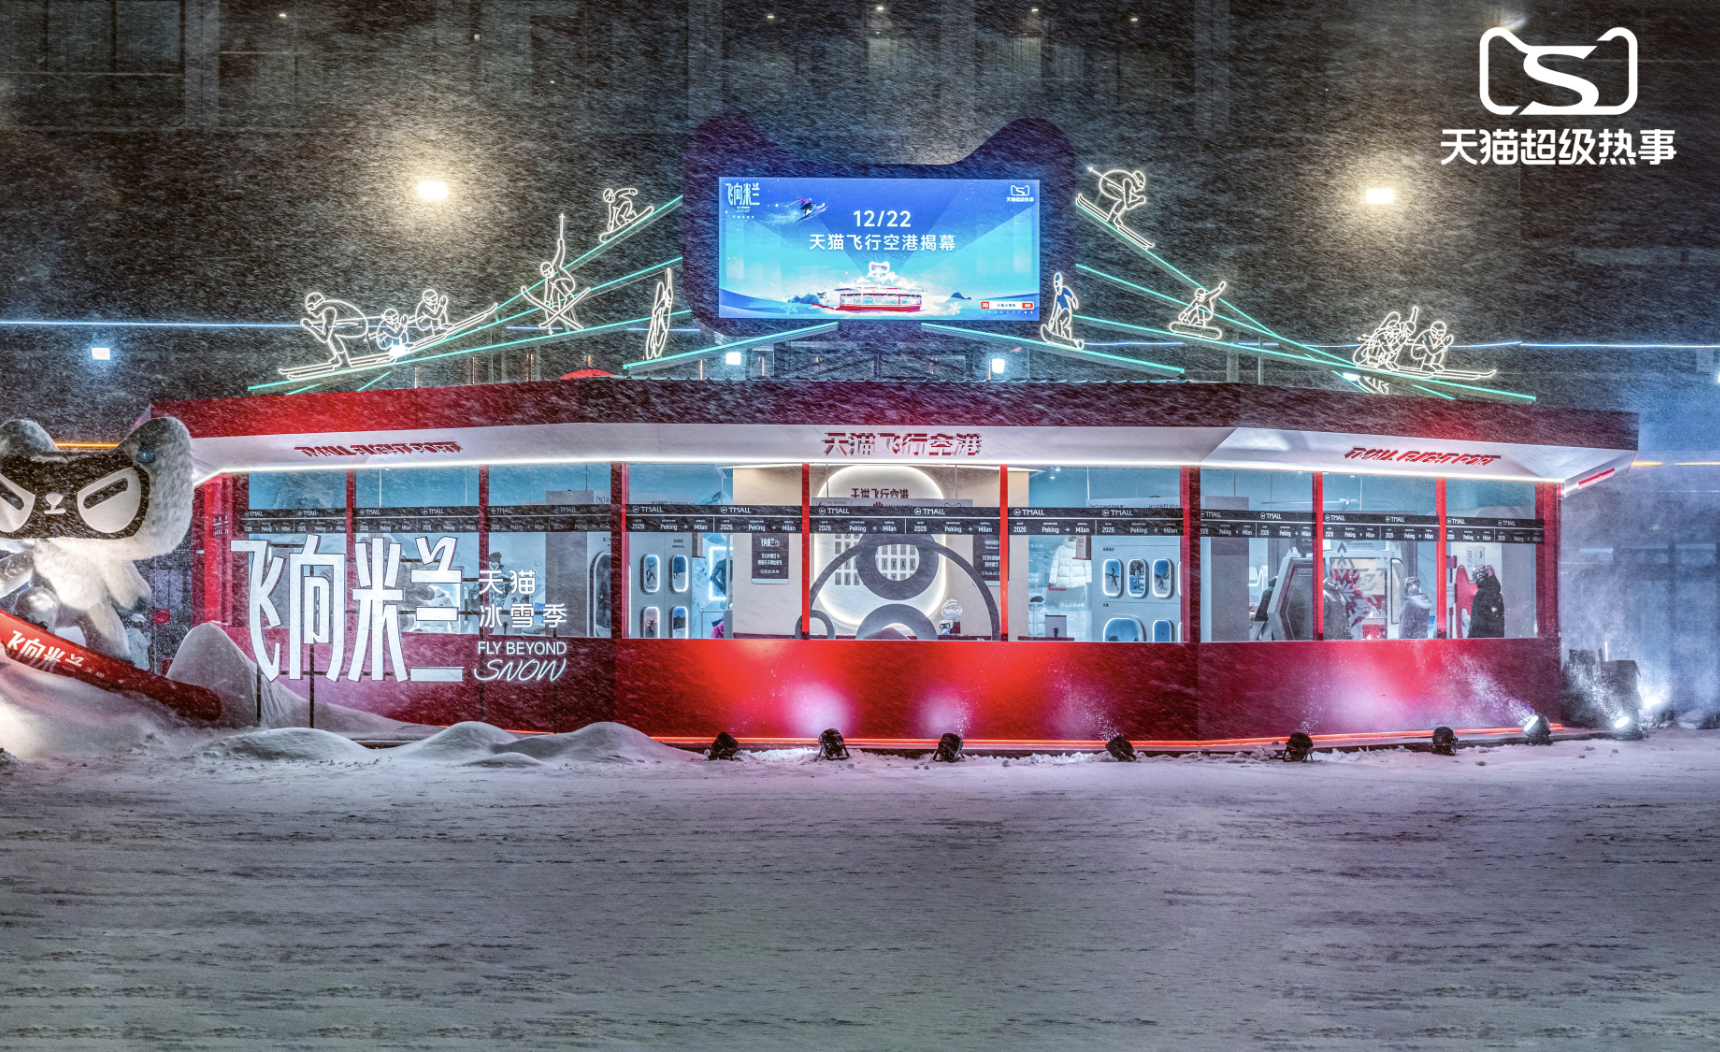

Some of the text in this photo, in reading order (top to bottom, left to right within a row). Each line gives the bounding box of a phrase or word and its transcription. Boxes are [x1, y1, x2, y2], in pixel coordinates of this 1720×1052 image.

[725, 182, 760, 205] 飞向米兰
[853, 210, 911, 227] 12/22
[809, 234, 956, 251] 天猫飞行空港揭幕
[822, 432, 982, 456] 天猫飞行空港
[478, 569, 535, 594] 天猫
[230, 534, 463, 682] 飞向米兰
[479, 603, 567, 628] 冰雪季
[477, 641, 567, 655] FLY BEYOND
[473, 658, 567, 682] SNOW
